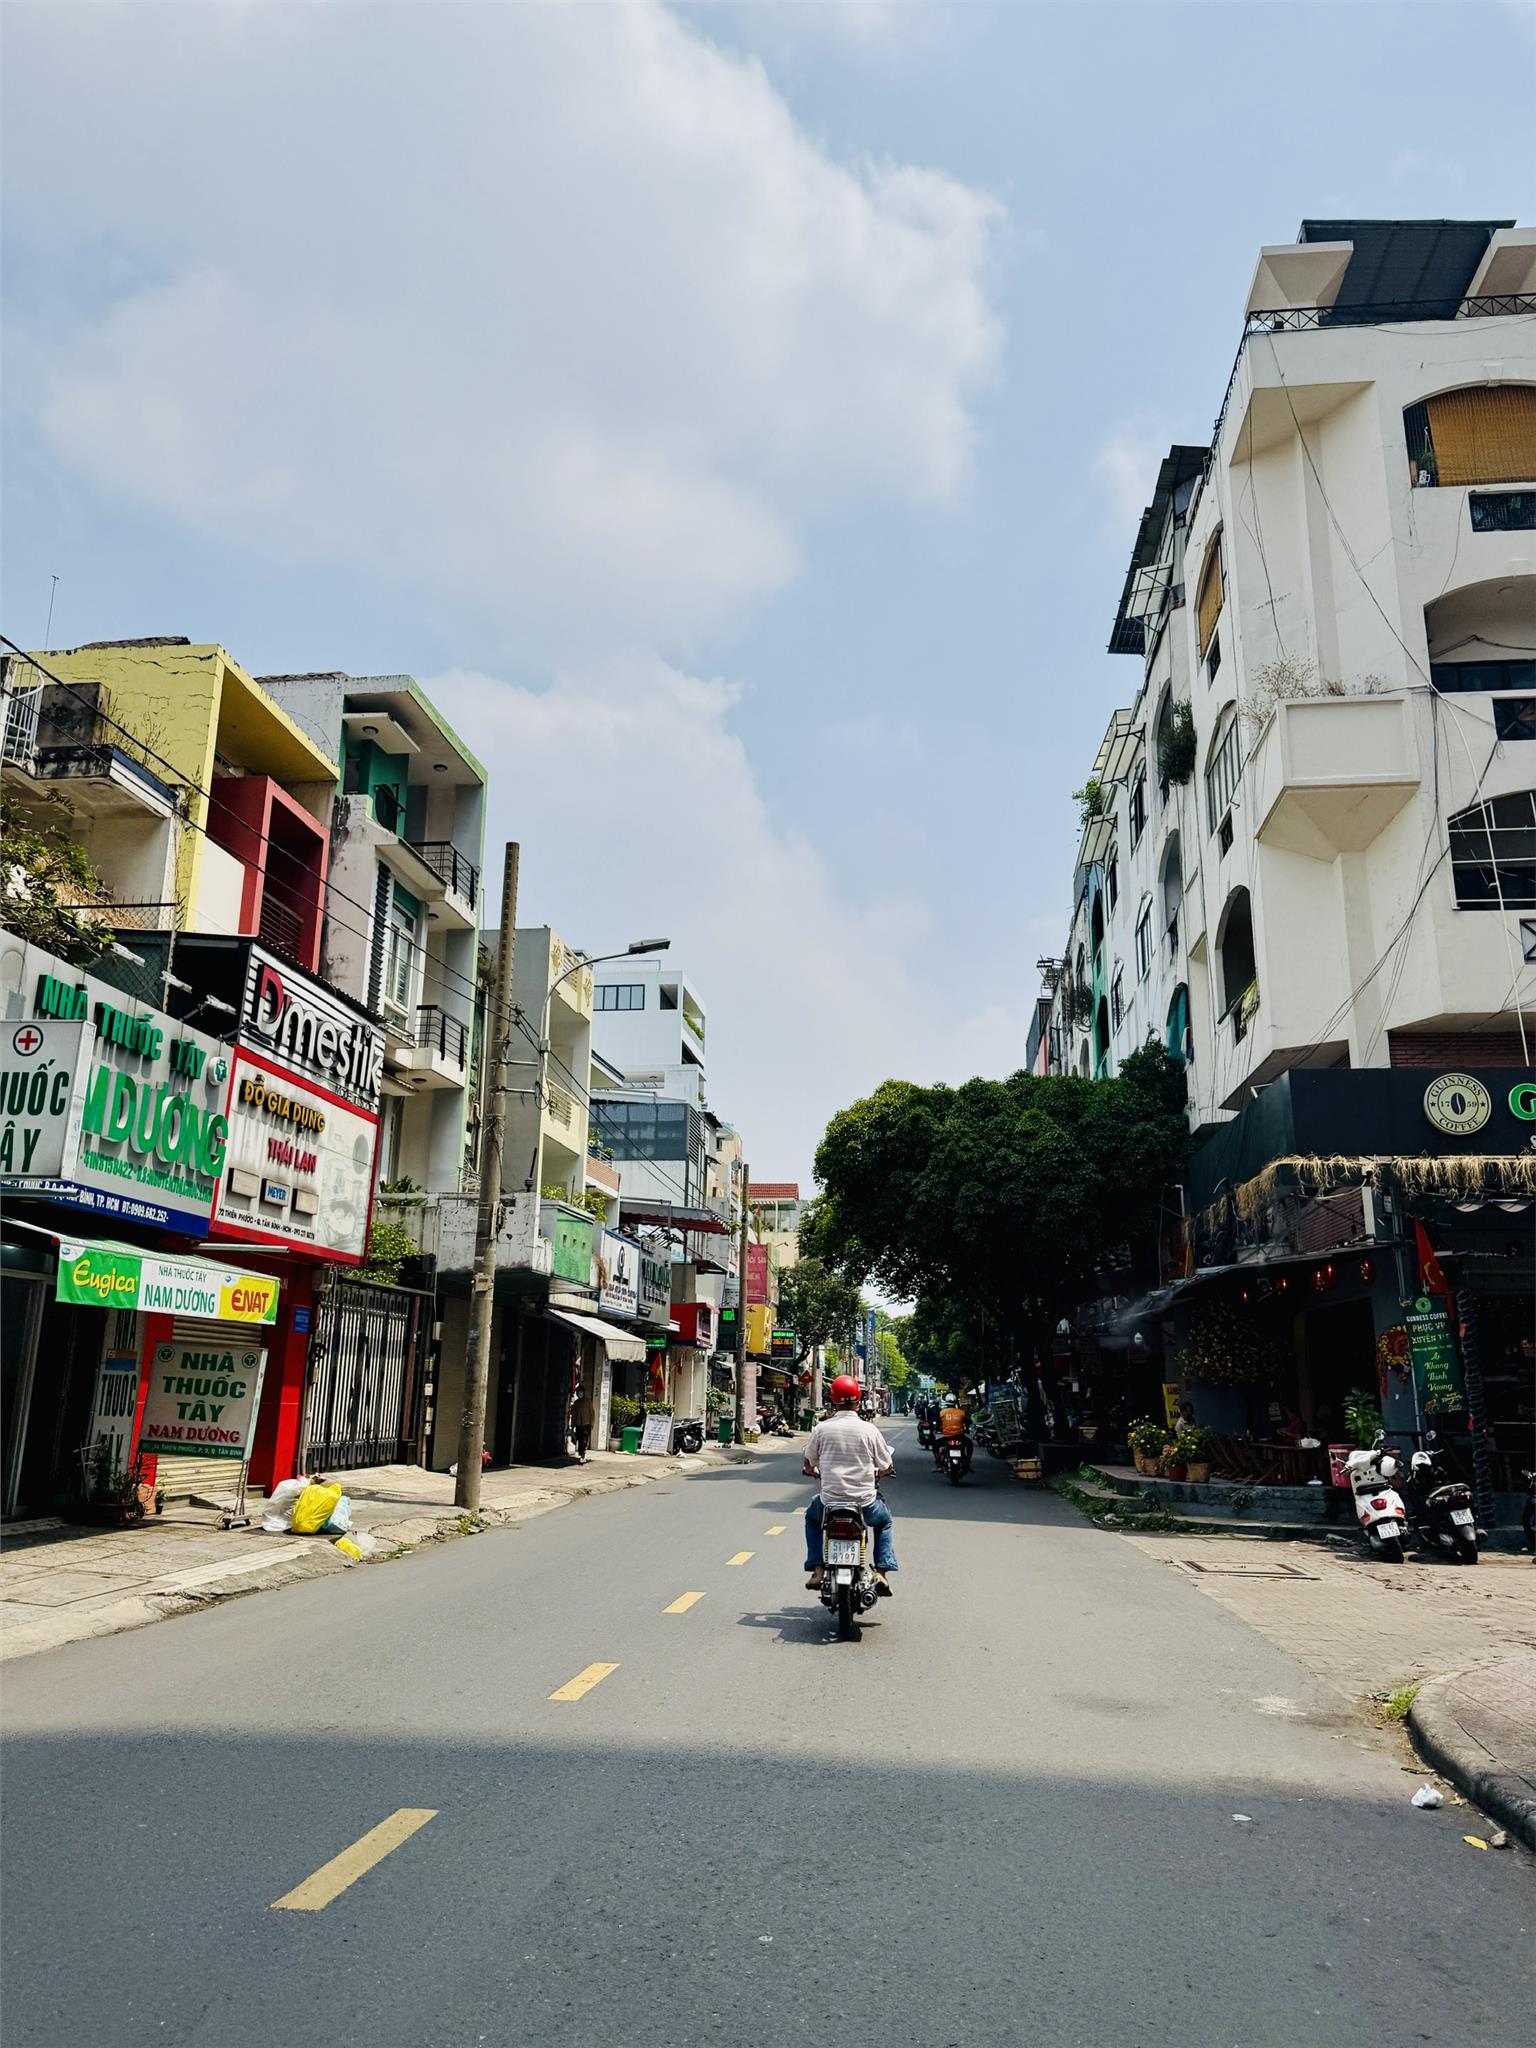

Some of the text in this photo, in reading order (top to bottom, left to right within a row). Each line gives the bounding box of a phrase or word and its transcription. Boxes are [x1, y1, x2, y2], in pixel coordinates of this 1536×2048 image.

[97, 1002, 164, 1061] THUỐC
[171, 1039, 207, 1080] TÂY
[0, 1059, 70, 1116] UỐC
[1431, 1076, 1483, 1098] GUINNESS
[244, 1074, 326, 1133] ĐỒ GIA DỤNG
[1439, 1117, 1481, 1131] COFFEE
[268, 1137, 317, 1174] THÁI LAN
[106, 1196, 120, 1212] HCM
[267, 1184, 287, 1201] MEYER
[72, 1259, 136, 1298] Eugica
[144, 1284, 216, 1313] NAM DƯƠNG
[231, 1289, 269, 1314] ENAT
[180, 1351, 235, 1373] NHÀ
[162, 1374, 247, 1399] THUỐC
[176, 1400, 225, 1423] TÂY
[147, 1424, 240, 1443] NAM DƯƠNG
